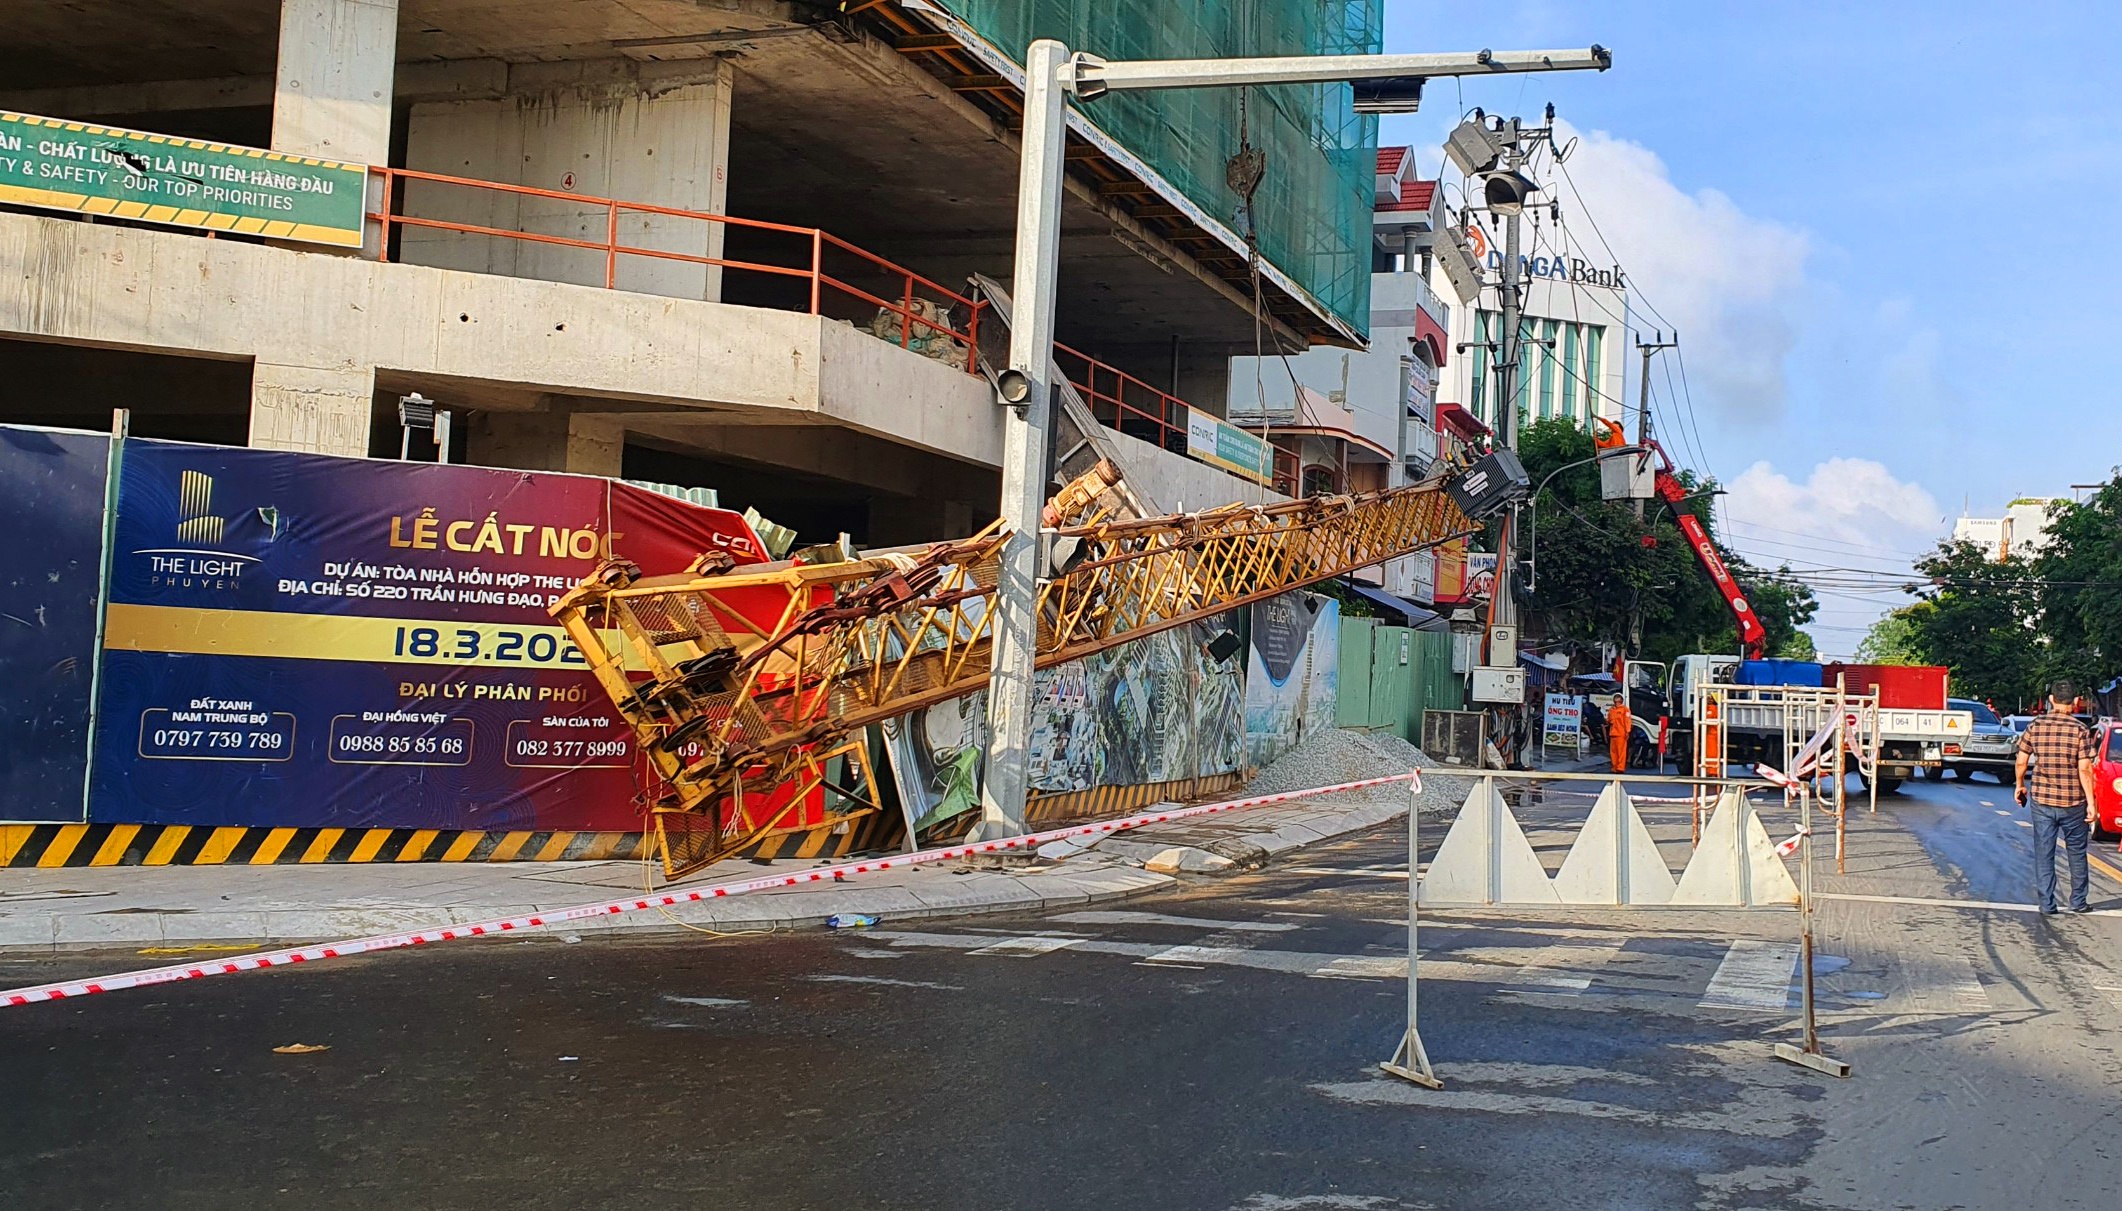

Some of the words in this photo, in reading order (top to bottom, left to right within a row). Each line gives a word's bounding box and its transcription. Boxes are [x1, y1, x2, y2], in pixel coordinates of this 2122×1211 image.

[39, 141, 88, 160] CHẤT
[155, 155, 176, 173] LÀ
[182, 160, 205, 177] ƯU
[210, 165, 246, 183] TIÊN
[251, 170, 297, 190] HÀNG
[301, 175, 333, 194] ĐẦU
[22, 160, 34, 175] &
[40, 163, 107, 185] SAFETY
[123, 175, 158, 192] OUR
[164, 180, 198, 197] TOP
[203, 186, 293, 210] PRIORITIES
[1571, 258, 1627, 288] Bank
[390, 507, 438, 550] LỄ
[446, 512, 534, 555] CẤT
[152, 556, 184, 574] THE
[189, 559, 244, 577] LIGHT
[324, 562, 350, 580] DỰ
[352, 562, 380, 579] ÁN:
[383, 564, 417, 581] TÒA
[420, 567, 454, 582] NHÀ
[458, 567, 492, 585] HỖN
[496, 572, 530, 590] HỢP
[534, 576, 564, 589] THE
[278, 580, 308, 596] ĐỊA
[311, 580, 342, 596] CHỈ:
[346, 580, 372, 597] SỐ
[373, 585, 407, 599] 220
[411, 585, 454, 602] TRẦN
[458, 590, 504, 604] HƯNG
[508, 593, 544, 608] ĐẠO,
[400, 682, 435, 700] ĐẠI
[444, 680, 467, 698] LÝ
[474, 684, 531, 700] PHÂN
[538, 685, 587, 702] PHỐI
[190, 696, 216, 710] ĐẤT
[218, 700, 252, 712] XANH
[172, 712, 202, 723] NAM
[204, 712, 248, 724] TRUNG
[249, 711, 268, 726] BỘ
[362, 712, 384, 726] ĐẠI
[385, 709, 418, 724] HỒNG
[420, 711, 446, 725] VIỆT
[542, 716, 567, 728] SÀN
[569, 714, 592, 728] CỦA
[592, 716, 609, 728] TÔI
[154, 729, 203, 747] 0797
[248, 731, 282, 750] 789
[340, 735, 384, 752] 0988
[388, 736, 410, 752] 85
[414, 737, 437, 754] 85
[441, 738, 463, 754] 68
[516, 739, 548, 756] 082
[550, 740, 584, 757] 377
[586, 740, 626, 758] 8999
